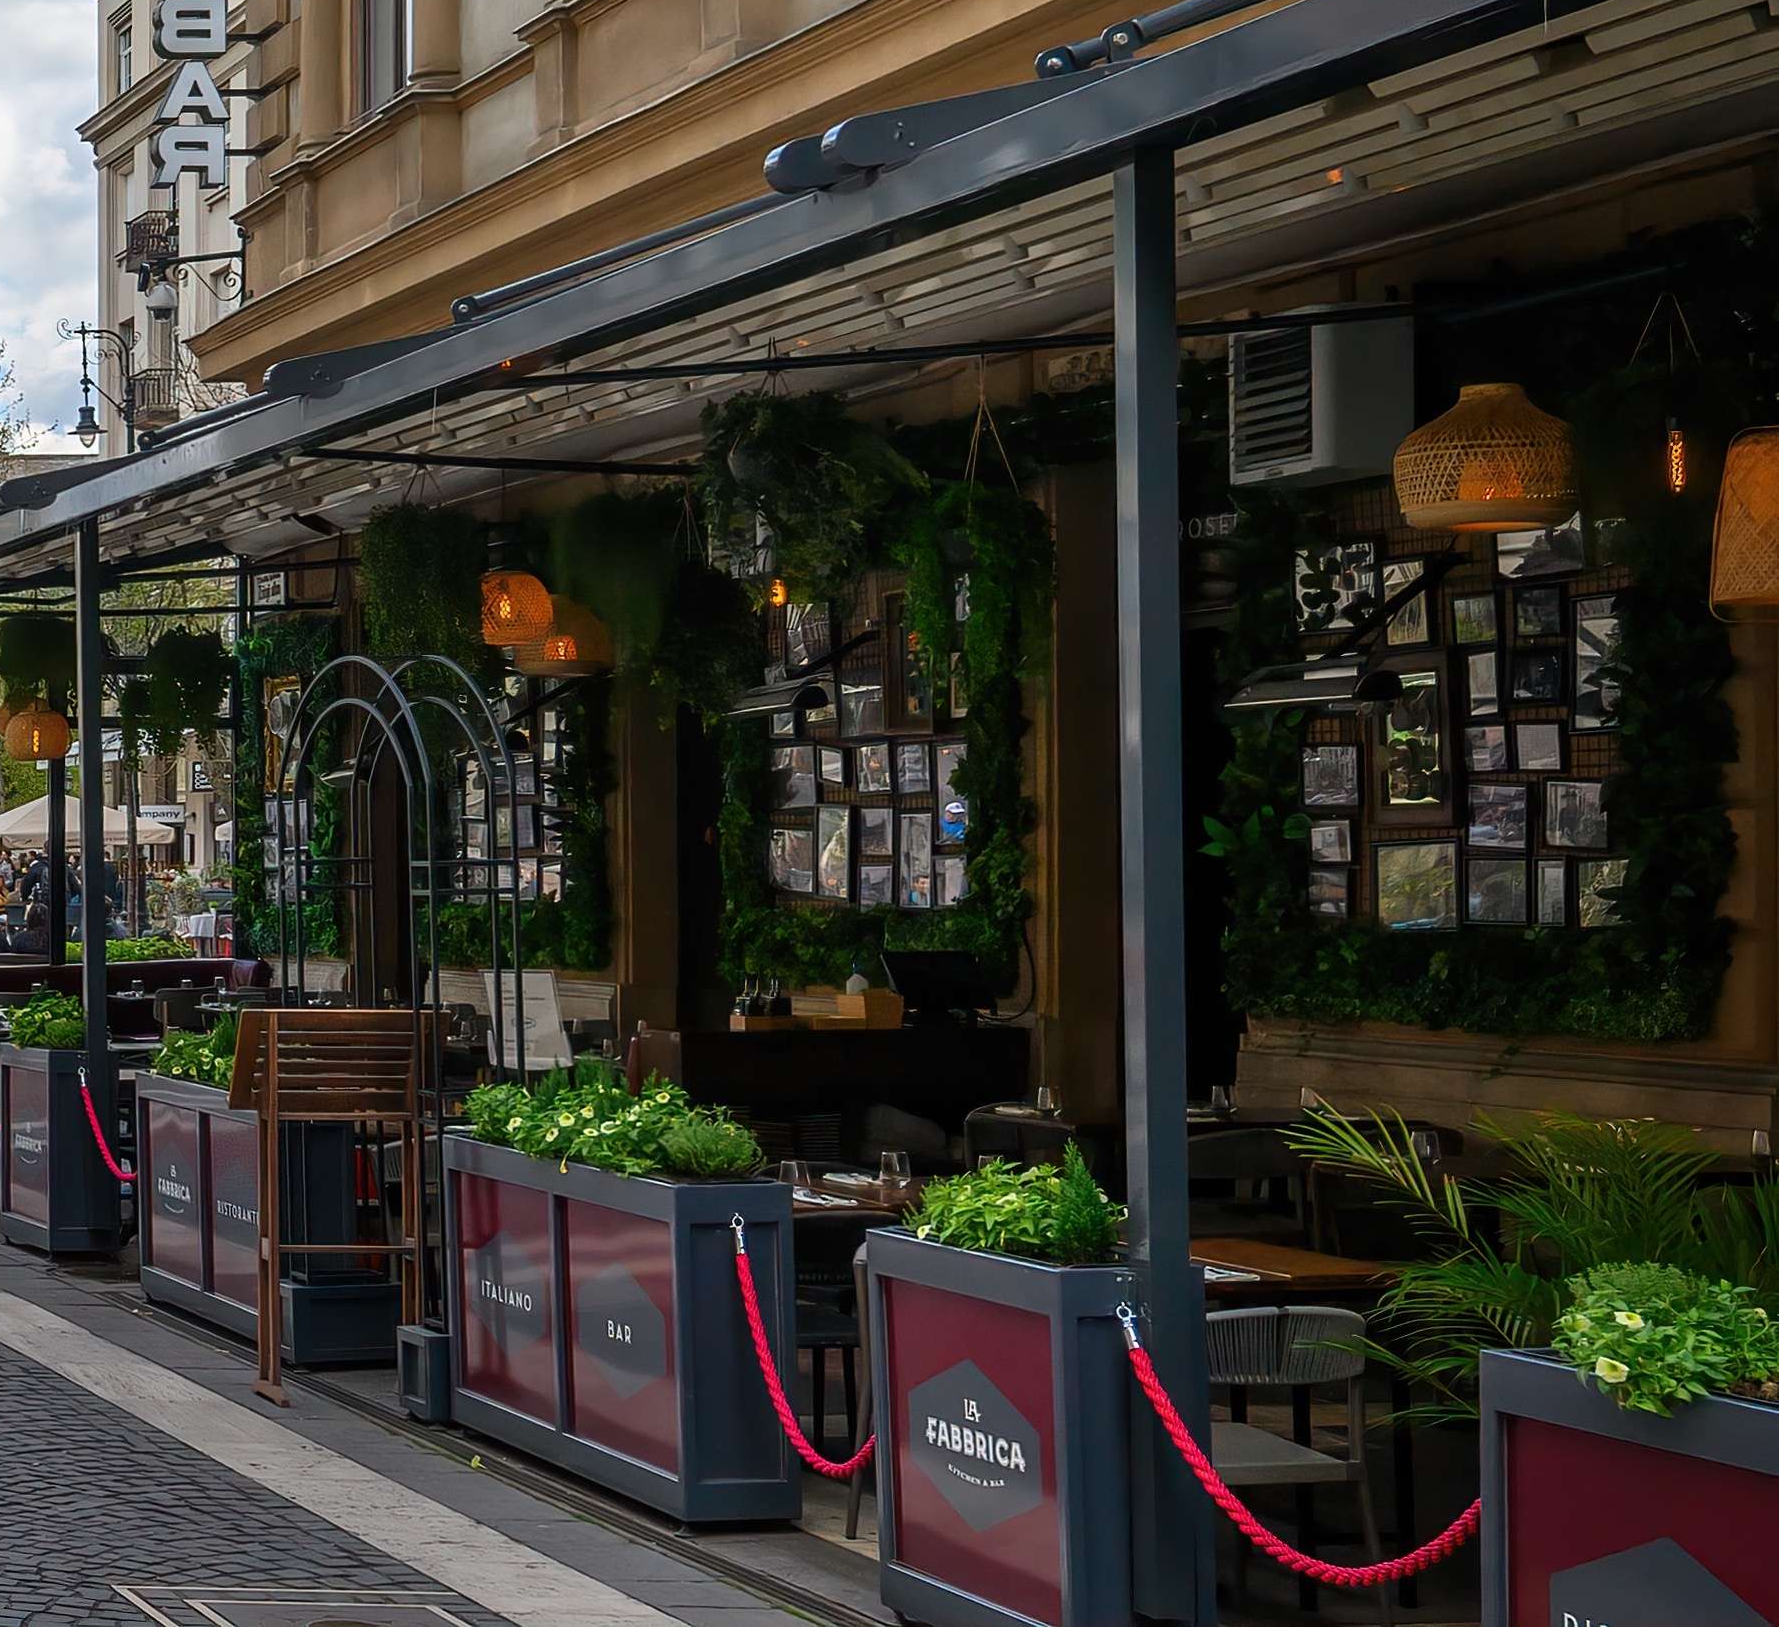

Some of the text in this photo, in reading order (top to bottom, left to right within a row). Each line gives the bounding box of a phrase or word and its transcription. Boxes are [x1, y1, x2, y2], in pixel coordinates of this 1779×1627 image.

[157, 1177, 192, 1203] FABBRICA
[481, 1279, 533, 1312] ITALIANO
[607, 1319, 632, 1344] BAR
[963, 1398, 982, 1423] LA
[926, 1416, 1027, 1474] FABBRICA
